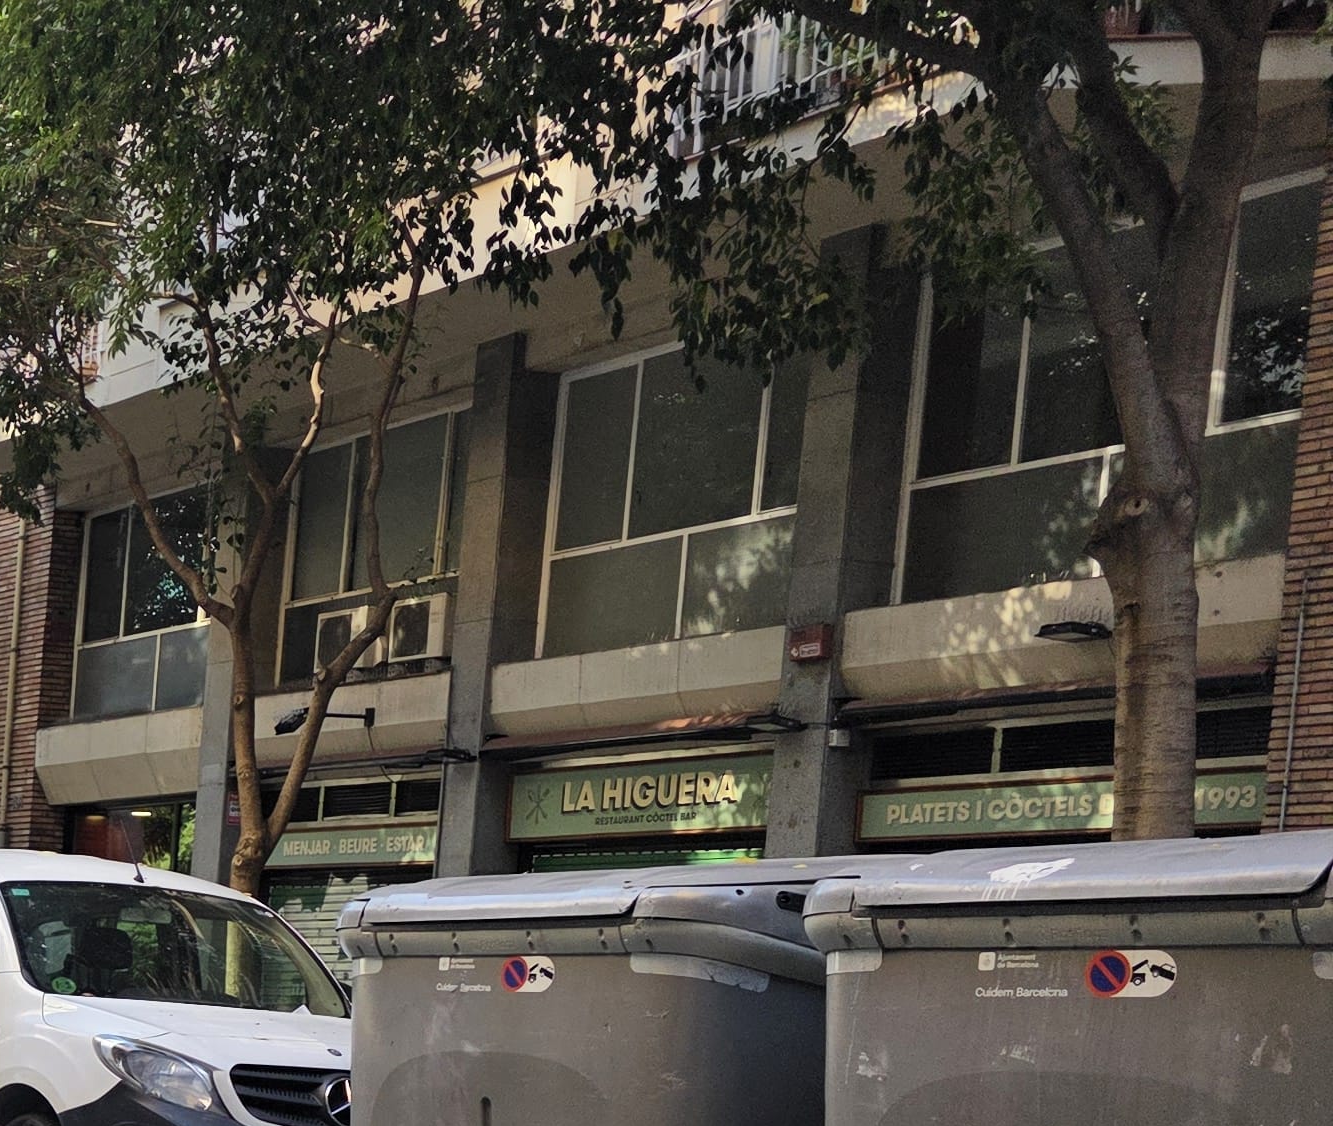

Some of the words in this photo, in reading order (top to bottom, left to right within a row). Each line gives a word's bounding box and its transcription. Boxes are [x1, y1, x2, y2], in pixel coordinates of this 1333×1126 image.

[562, 781, 596, 814] LA
[601, 770, 738, 812] HIGUERA
[886, 801, 970, 825] PLATETS
[975, 800, 982, 821] I
[987, 792, 1093, 821] CÒCTELS
[1194, 785, 1257, 811] 1993
[595, 814, 646, 826] RESTAURANT
[680, 811, 698, 822] BAR
[283, 839, 331, 857] MENJAR
[339, 837, 377, 855] BEURE
[386, 835, 426, 853] ESTAR
[975, 986, 1014, 998] Cuidem
[1015, 986, 1069, 998] Barcelona
